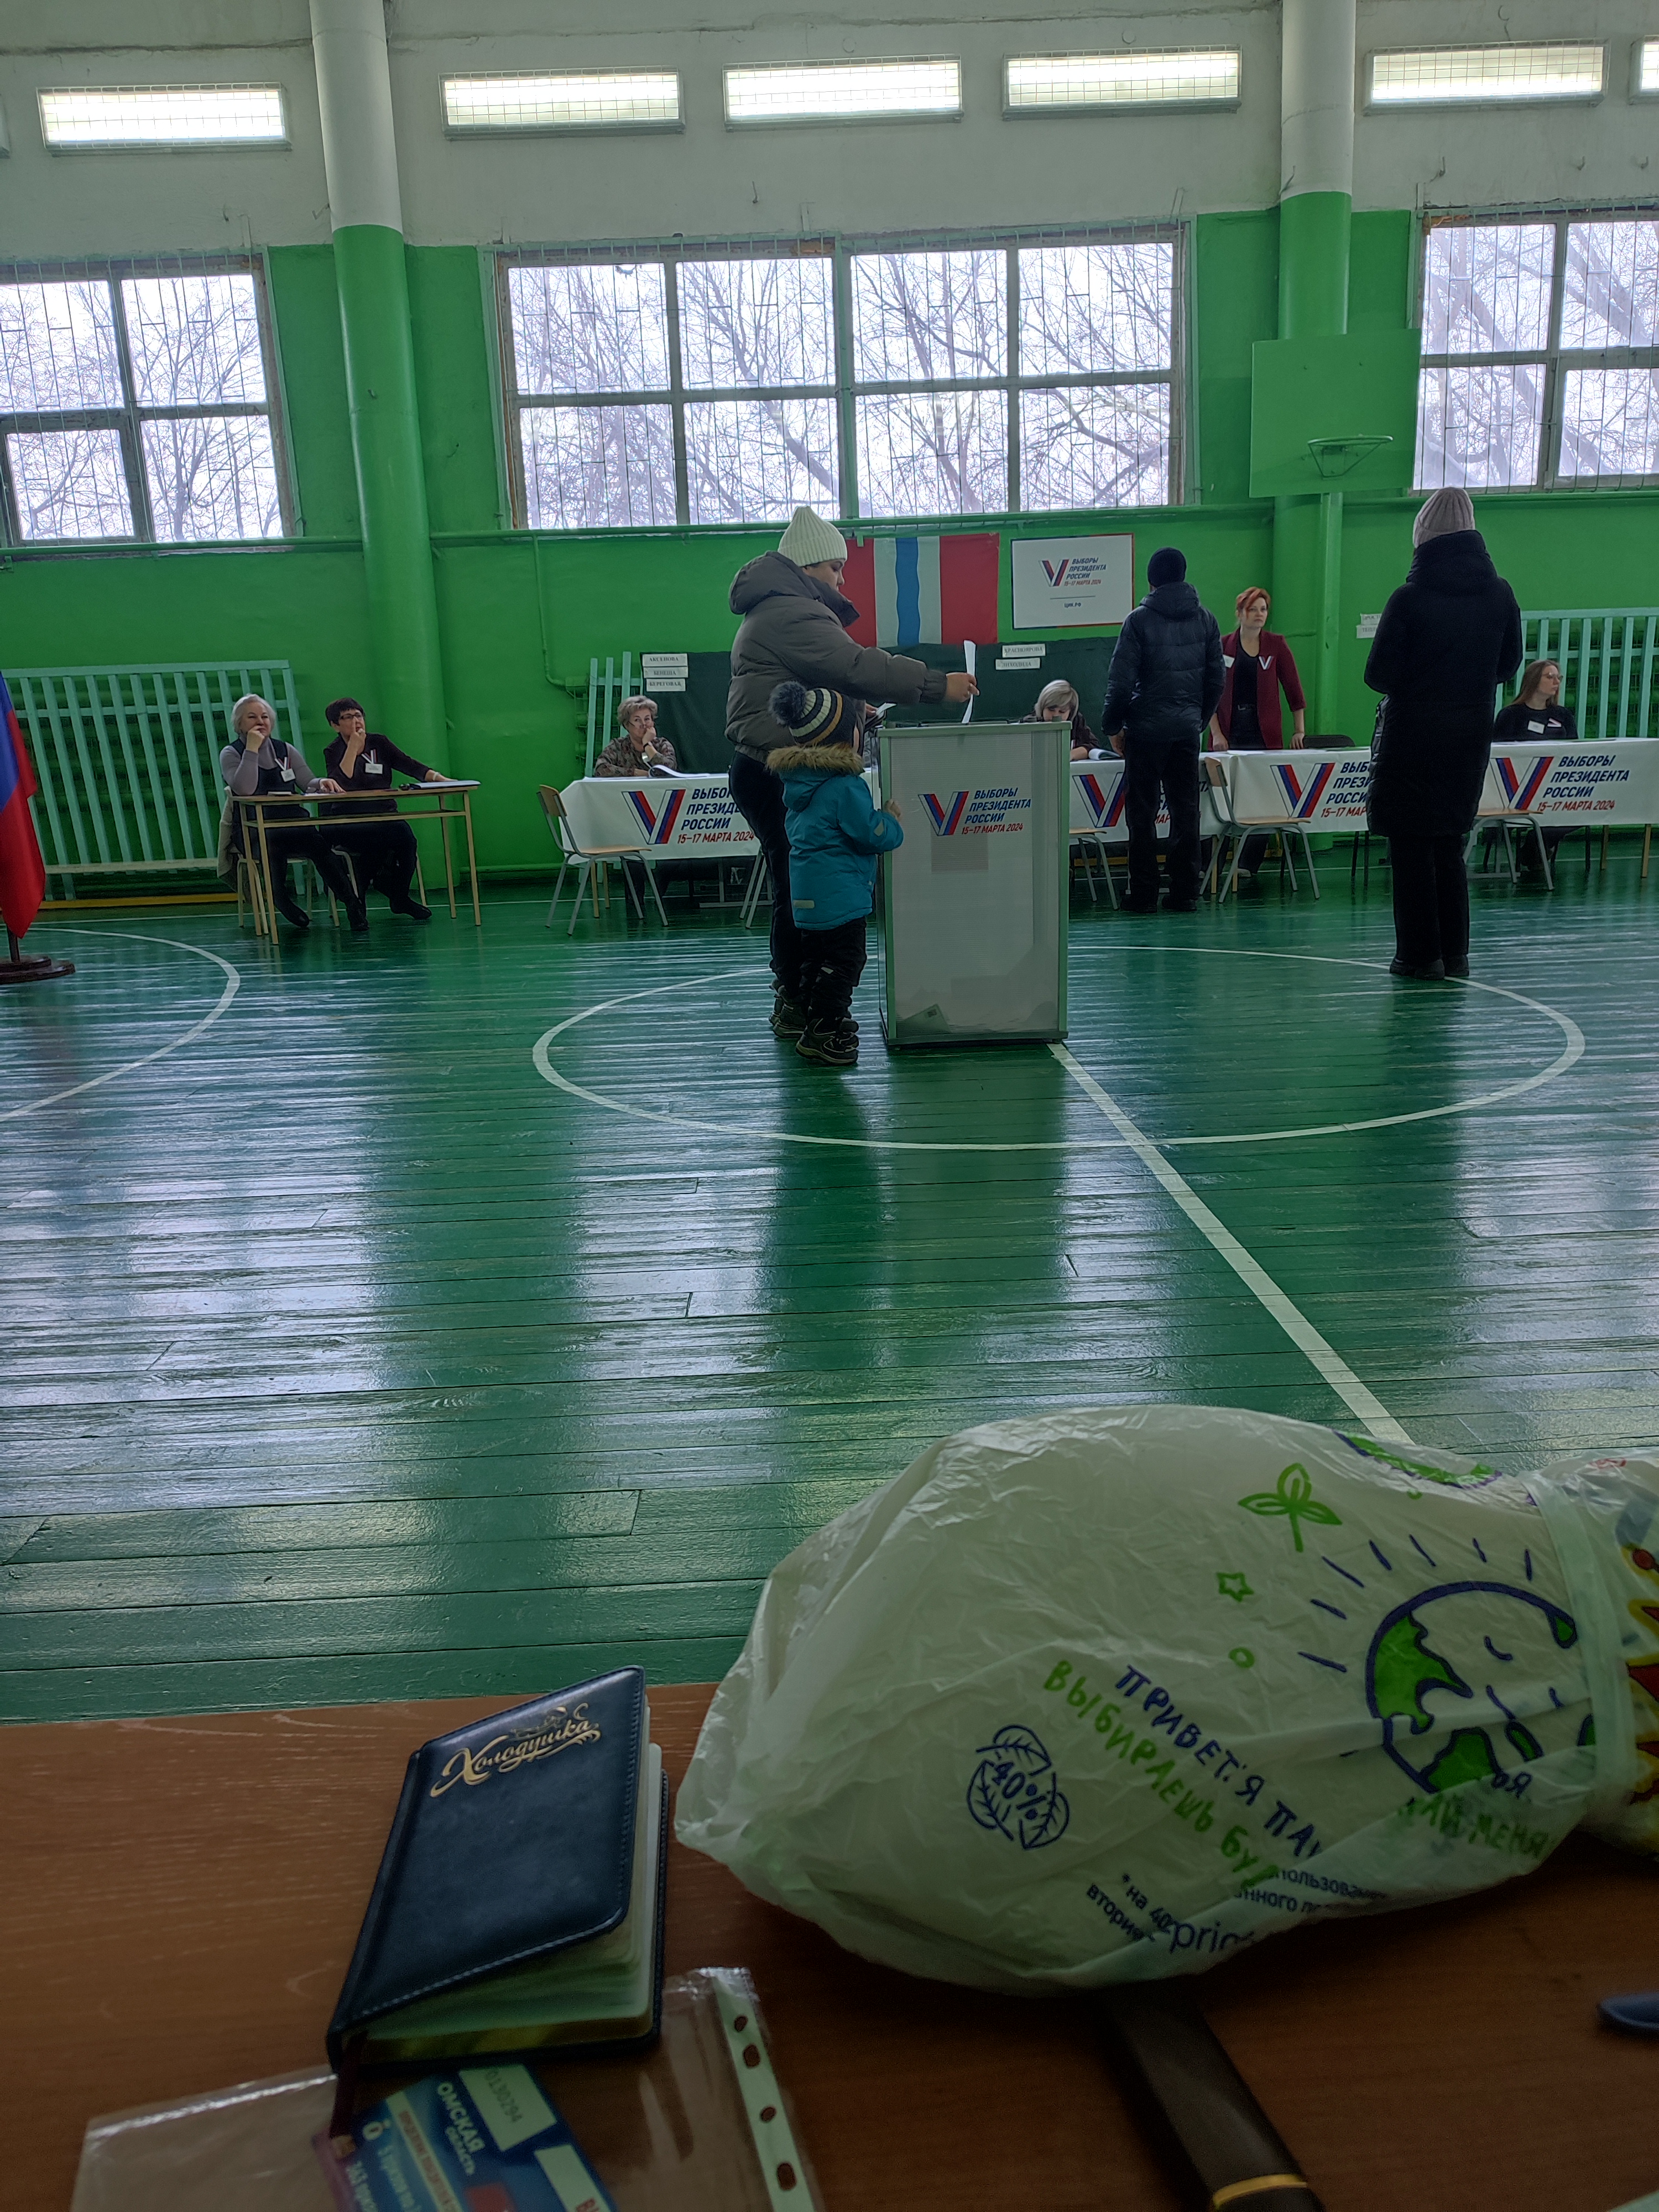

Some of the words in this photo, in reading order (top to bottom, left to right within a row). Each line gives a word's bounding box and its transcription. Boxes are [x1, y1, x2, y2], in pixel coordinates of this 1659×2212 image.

[1340, 761, 1370, 773] ВЫБ
[1558, 755, 1616, 767] ВЫБОРЫ
[1551, 770, 1630, 784] ПРЕЗИДЕНТА
[974, 787, 1018, 799] ВЫБОРЫ
[1543, 786, 1595, 798] РОССИИ
[969, 799, 1031, 812] ПРЕЗИДЕНТА
[1345, 806, 1368, 817] МАР
[1562, 801, 1592, 811] МАРТА
[1593, 800, 1615, 811] 2024
[681, 817, 731, 830] РОССИИ
[964, 812, 1005, 824] РОССИИ
[982, 825, 1005, 833] МАРТА
[1006, 823, 1023, 832] 2024
[702, 832, 731, 843] МАРТА
[733, 831, 754, 841] 2024
[1043, 1660, 1214, 1833] ВЫБИРАЕШЬ
[437, 2080, 486, 2153] ОМСКАЯ
